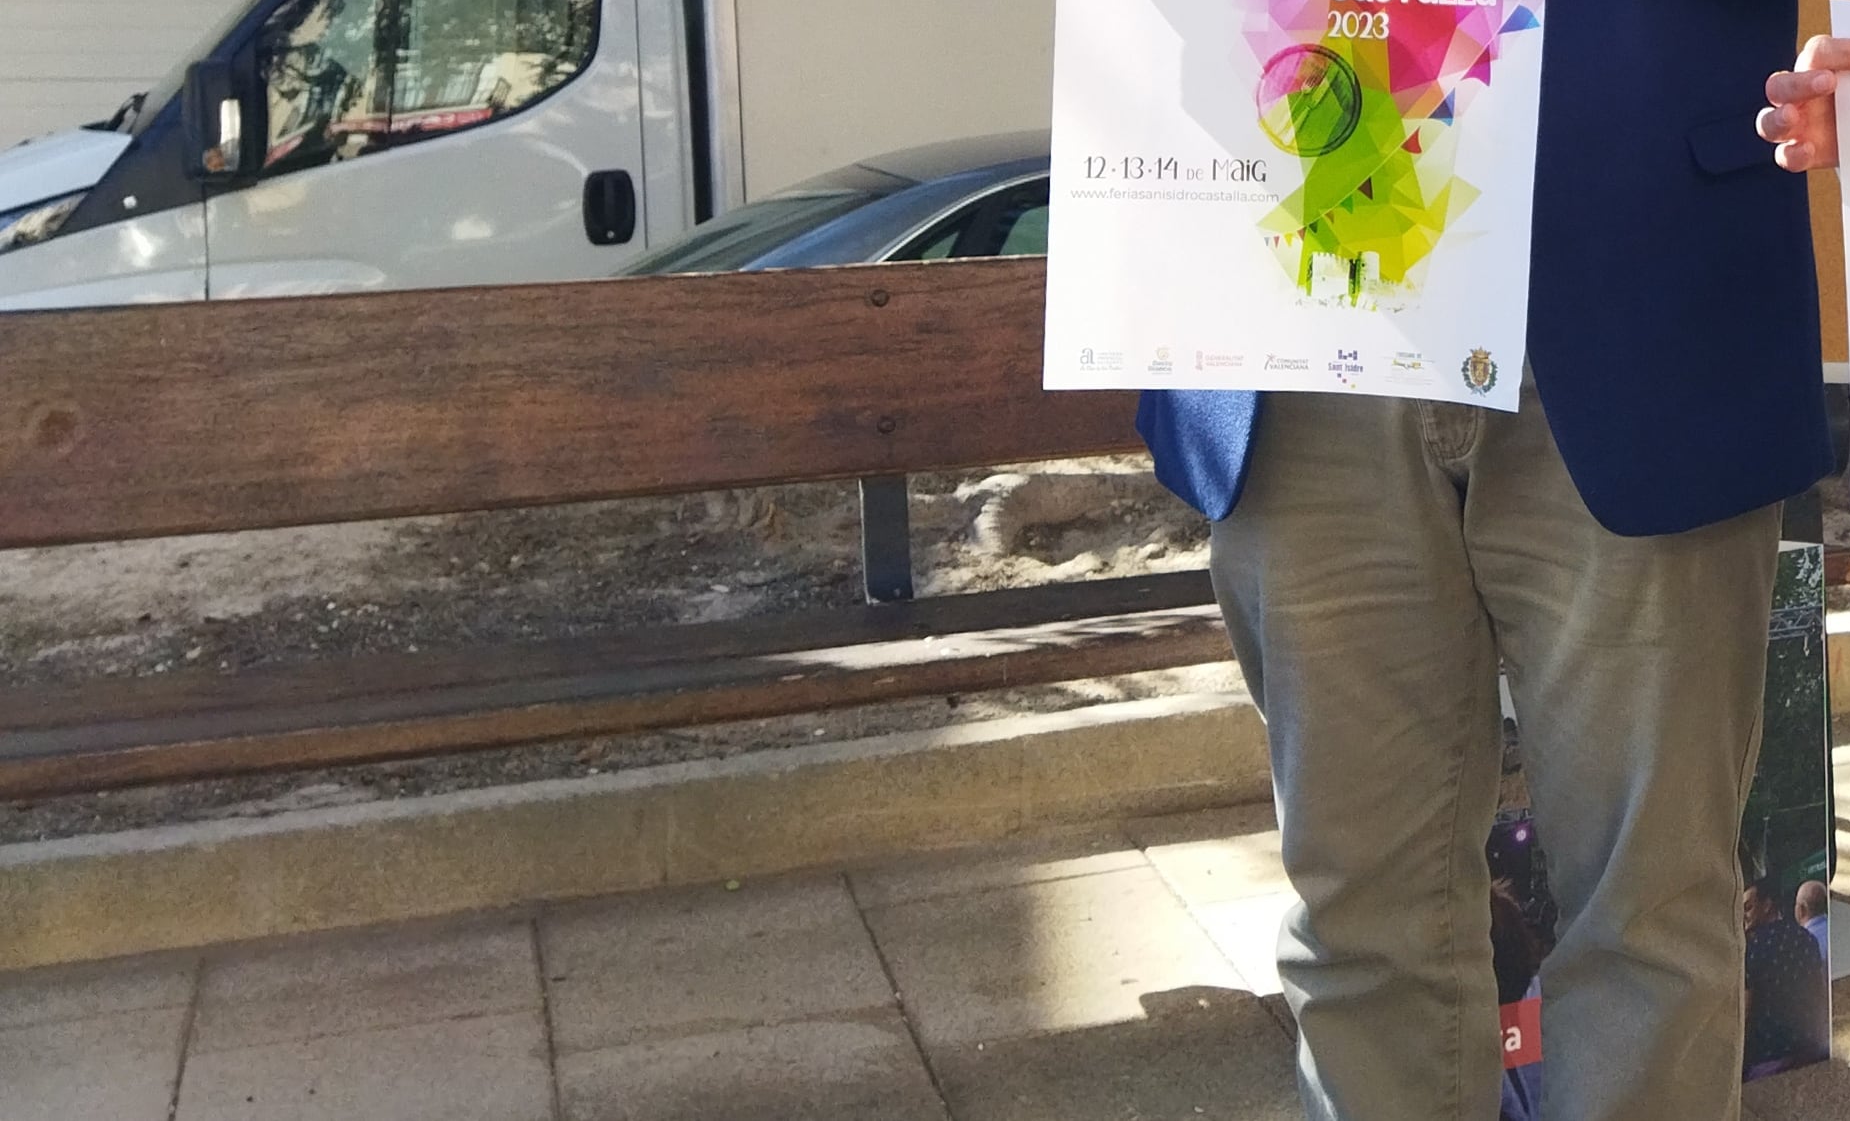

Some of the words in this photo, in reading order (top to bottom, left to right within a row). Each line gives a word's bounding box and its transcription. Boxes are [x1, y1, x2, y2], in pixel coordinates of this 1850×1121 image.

[1327, 10, 1390, 40] 2023
[1071, 187, 1279, 205] www.feriasanisidrocastalla.com
[1328, 362, 1343, 372] Sant
[1344, 363, 1363, 374] Isidre
